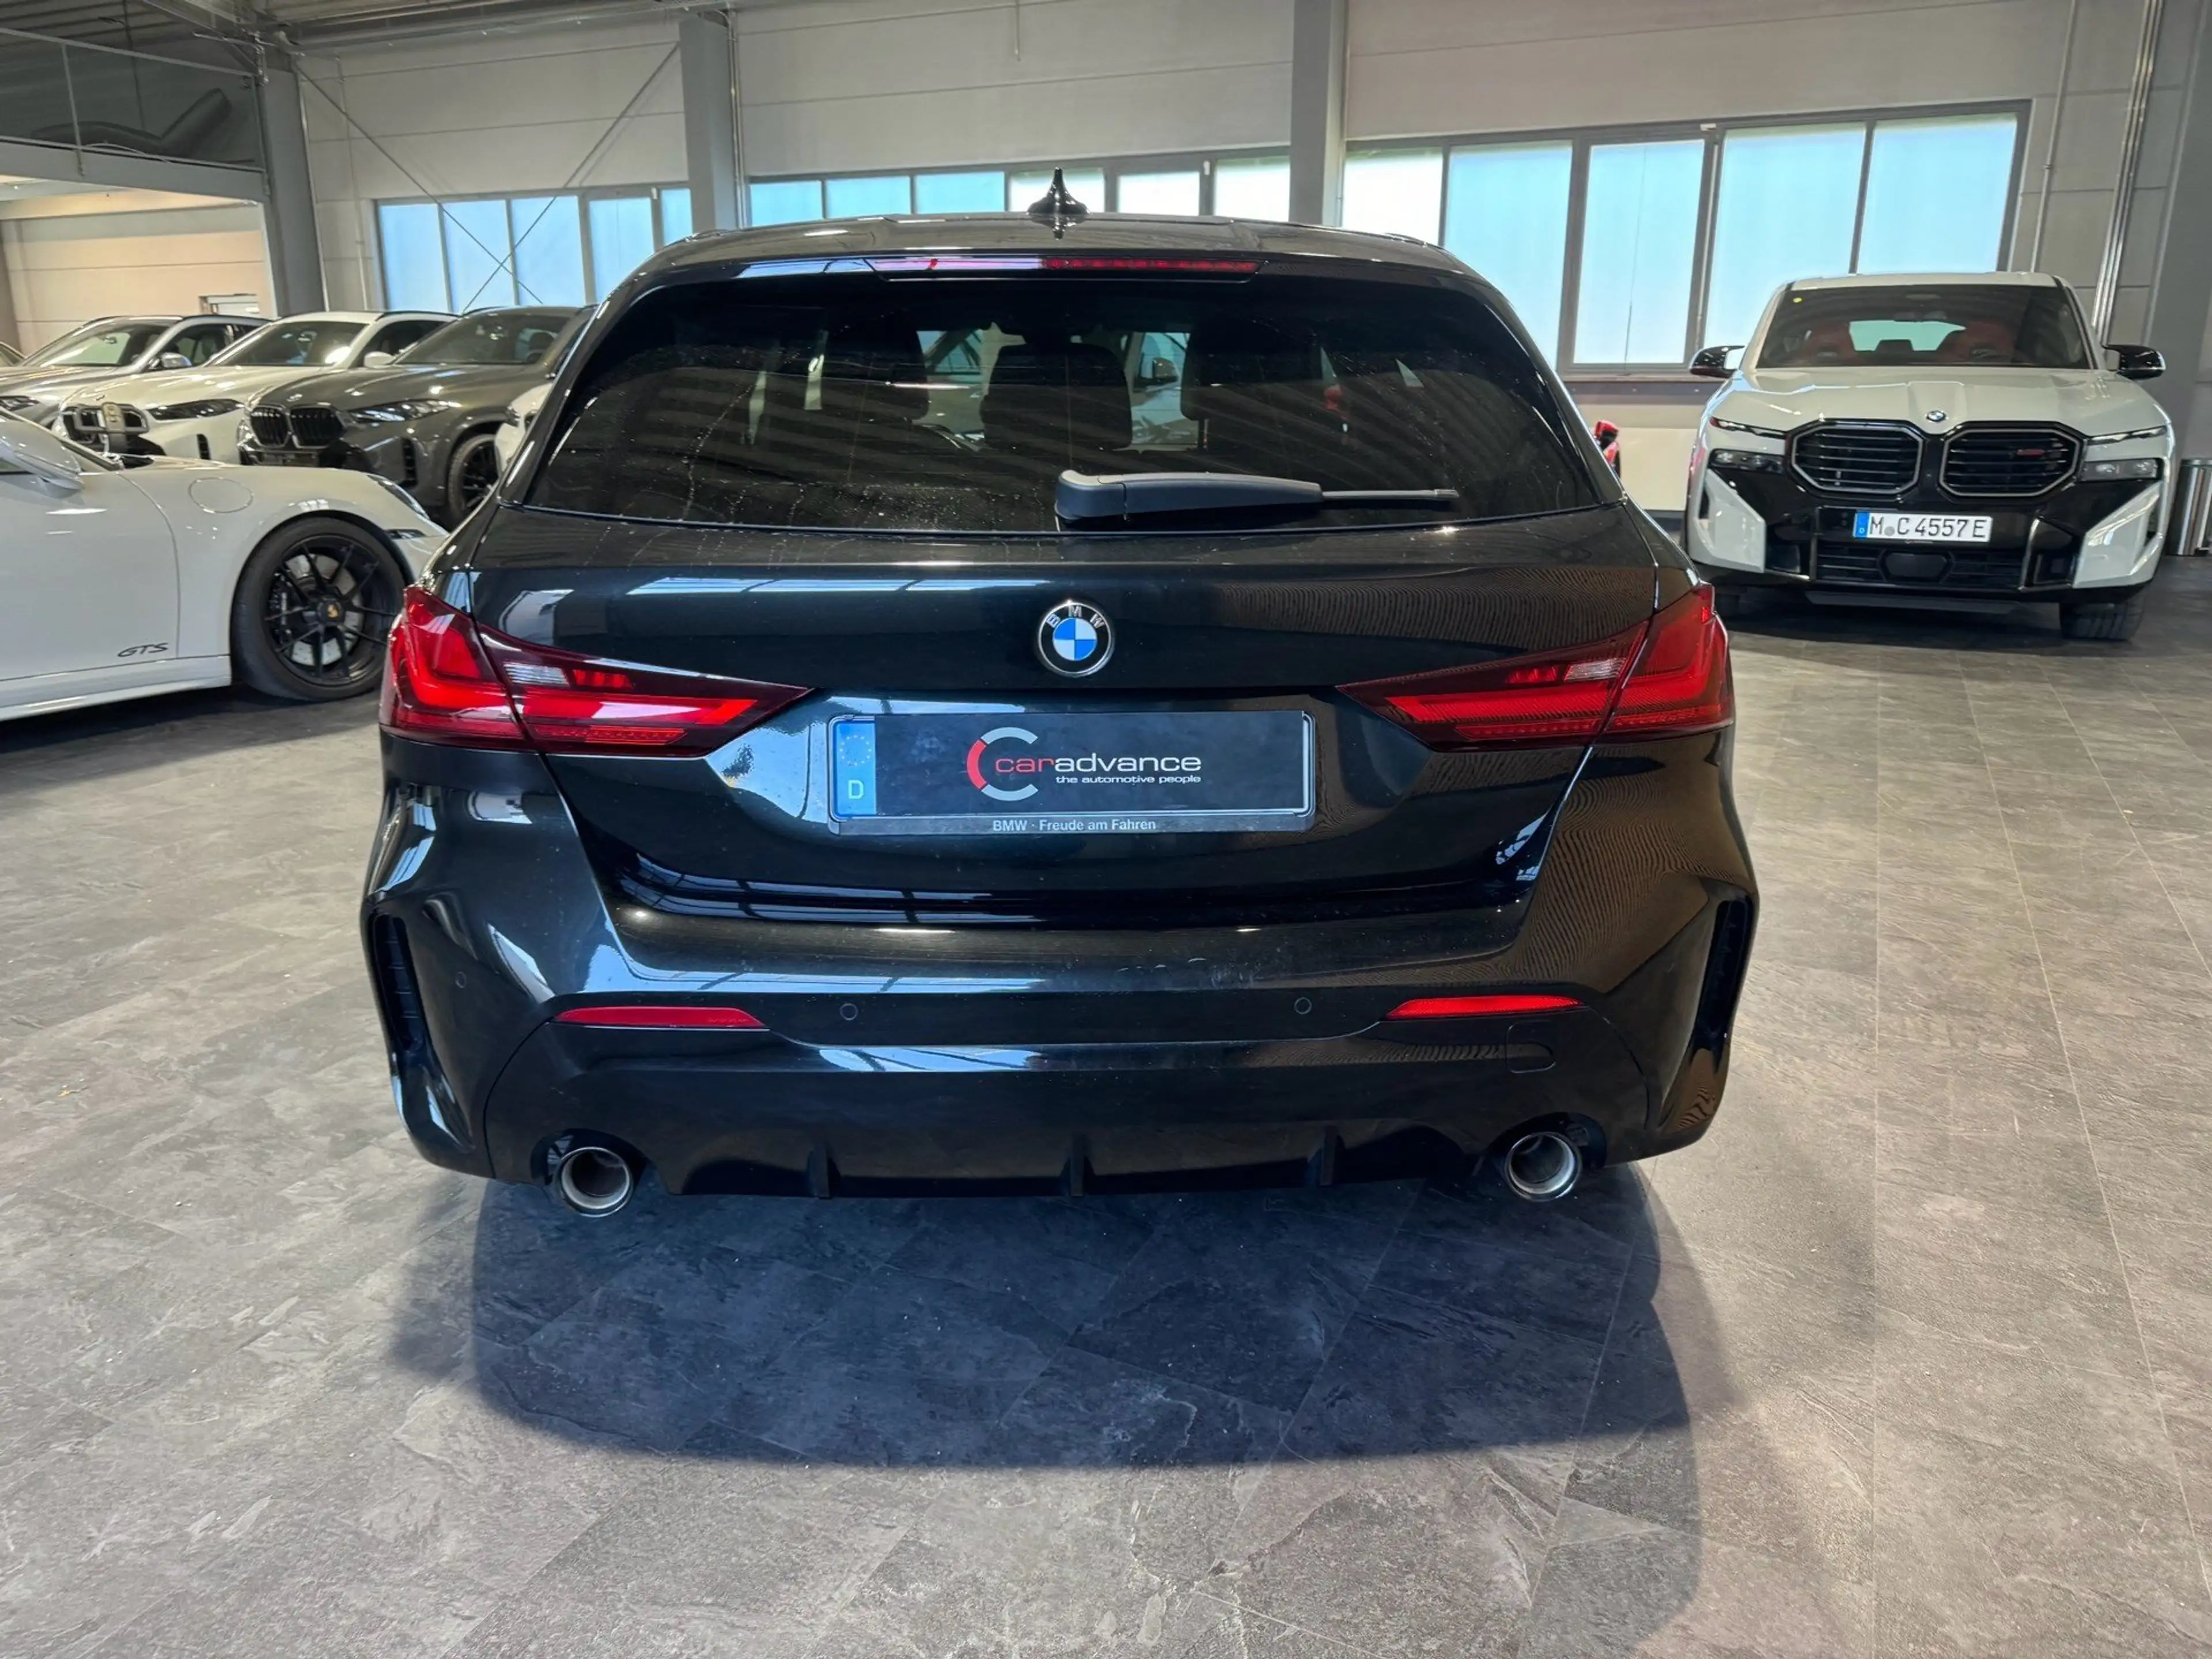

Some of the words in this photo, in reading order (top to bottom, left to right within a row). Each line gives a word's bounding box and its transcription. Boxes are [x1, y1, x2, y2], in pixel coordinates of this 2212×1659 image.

[1869, 516, 1884, 535] M
[1897, 517, 1910, 535] C
[1046, 605, 1105, 628] BMW
[118, 642, 169, 657] GTS
[995, 752, 1202, 772] caradvance
[849, 779, 864, 799] D
[1082, 775, 1155, 784] automotive
[1158, 775, 1201, 785] people
[993, 820, 1027, 831] BMW
[1040, 820, 1084, 831] Freude
[1088, 821, 1108, 830] am
[1112, 819, 1156, 830] Fahren
